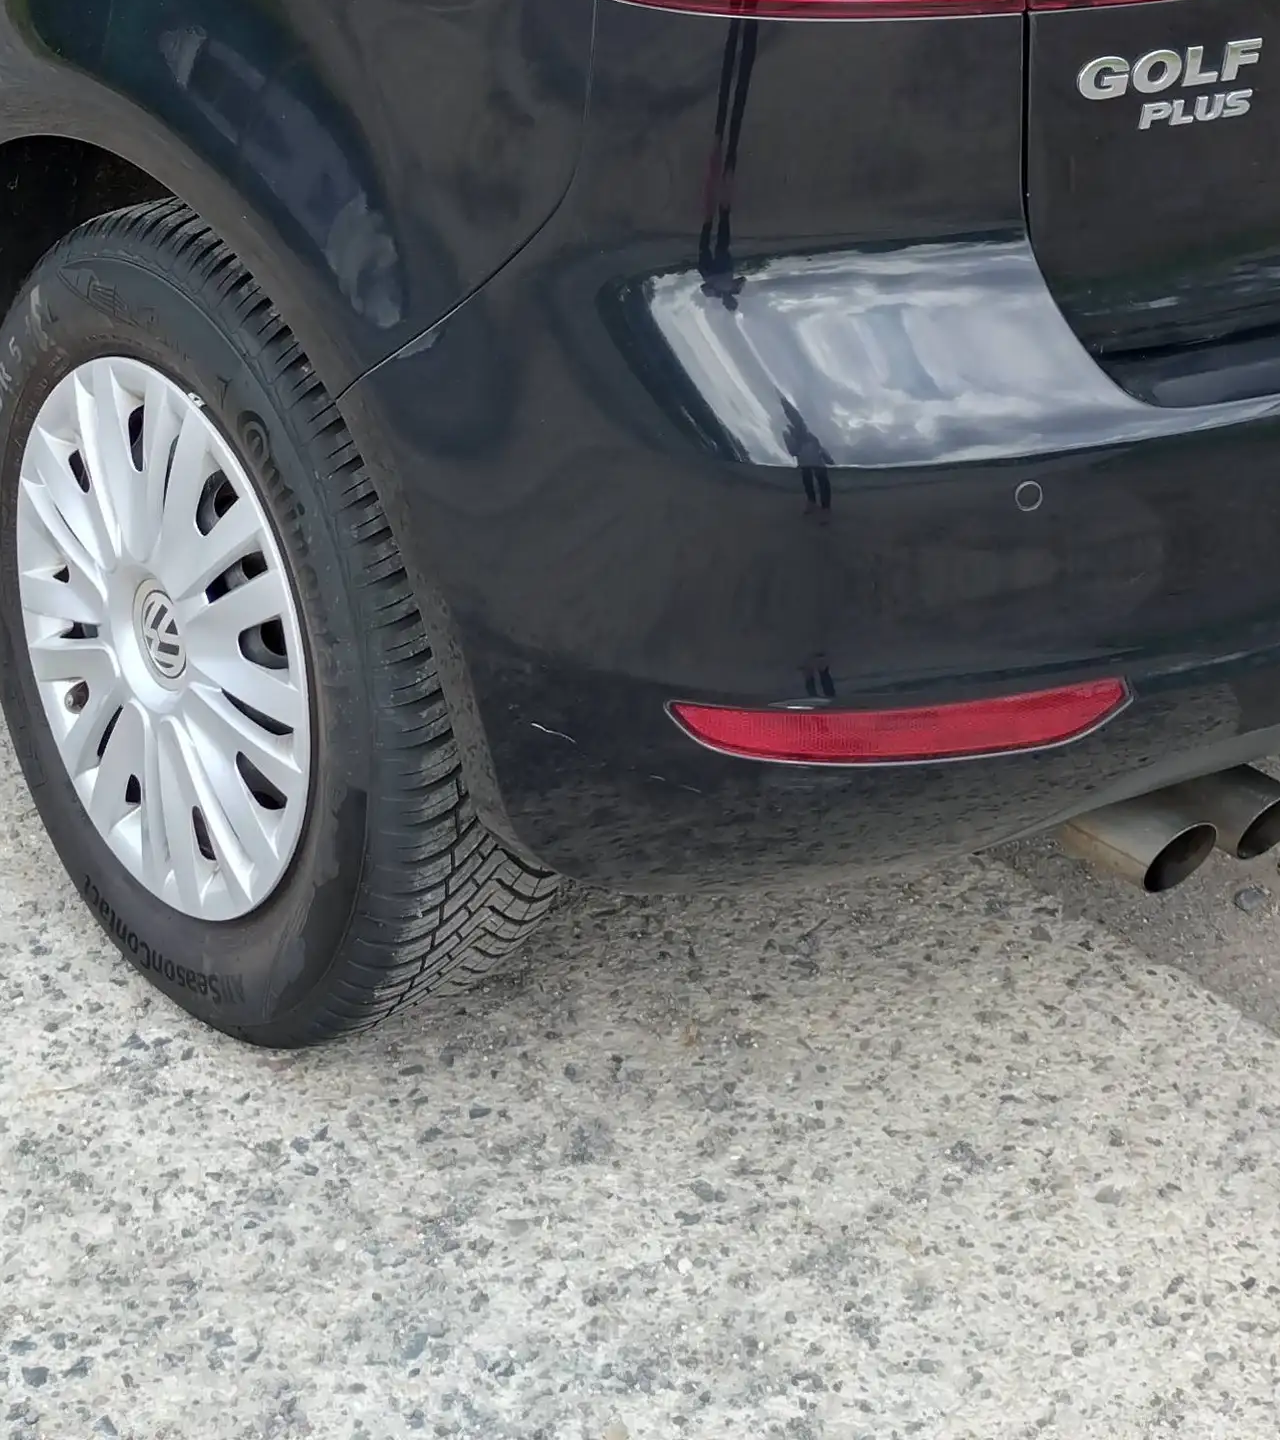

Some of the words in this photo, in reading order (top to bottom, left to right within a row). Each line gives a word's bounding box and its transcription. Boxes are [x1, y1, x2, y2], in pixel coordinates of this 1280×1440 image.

[1076, 37, 1264, 101] GOLF
[1137, 88, 1253, 140] PLUS
[83, 873, 246, 1004] AllSeasonContact
